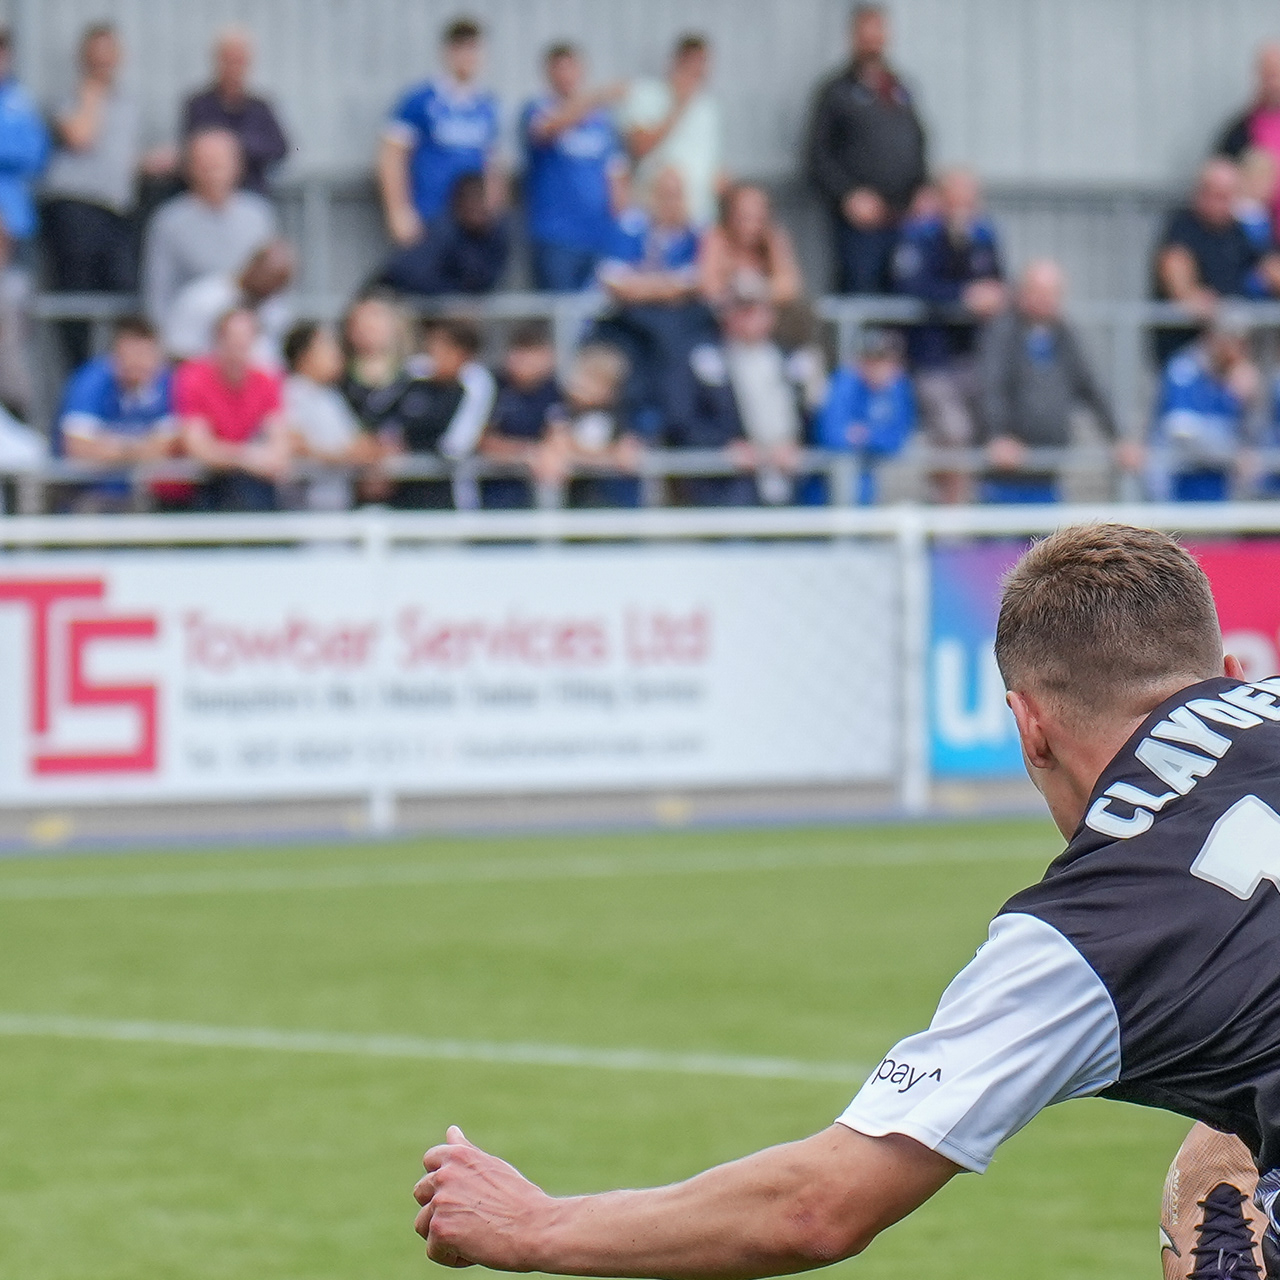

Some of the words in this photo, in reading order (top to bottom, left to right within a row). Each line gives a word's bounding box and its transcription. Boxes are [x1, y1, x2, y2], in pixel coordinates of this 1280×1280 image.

[183, 607, 376, 674] Towbar
[396, 604, 606, 672] Services
[622, 602, 713, 668] Ltd
